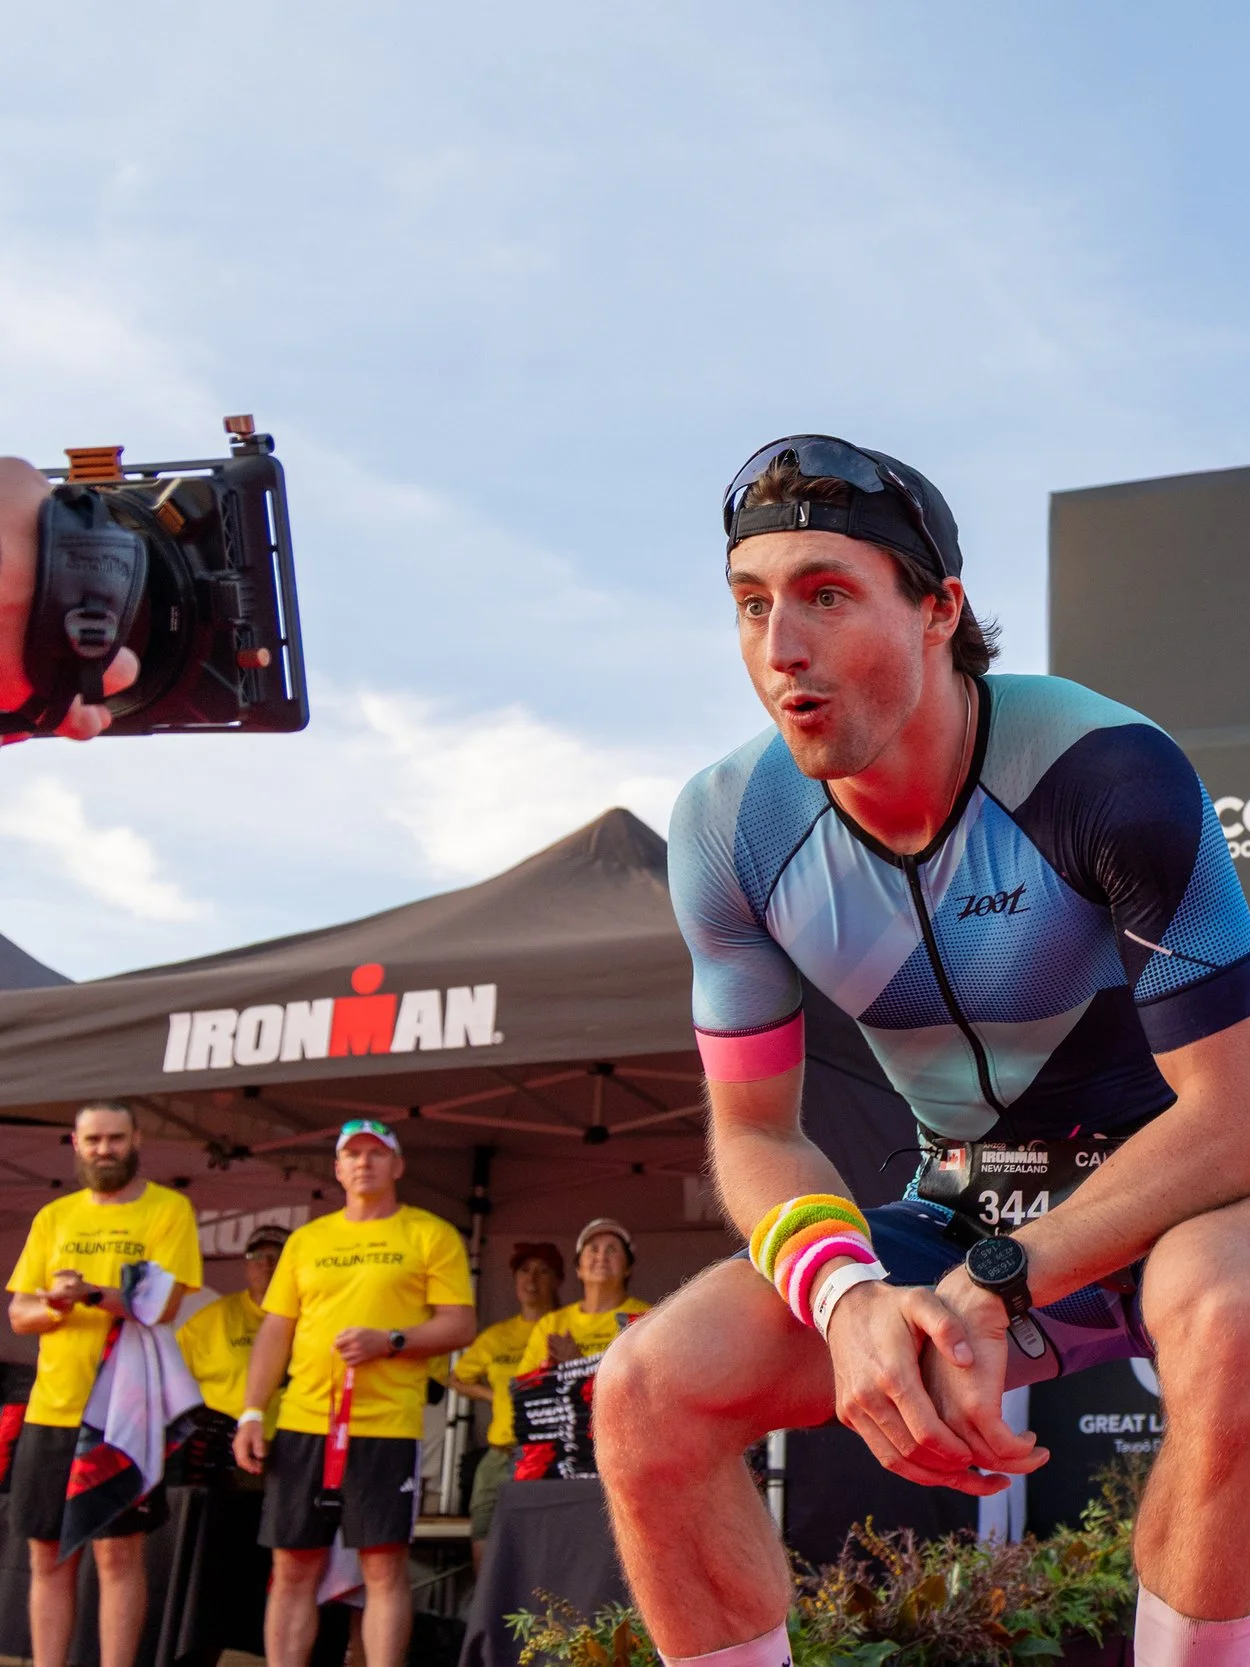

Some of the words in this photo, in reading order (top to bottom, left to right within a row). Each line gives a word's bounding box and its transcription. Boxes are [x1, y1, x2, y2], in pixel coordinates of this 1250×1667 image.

[162, 962, 498, 1073] IRONMAN
[981, 1144, 1049, 1165] IRONMAN
[981, 1164, 1003, 1174] NEW
[1004, 1165, 1048, 1175] ZEALAND
[978, 1189, 1050, 1226] 344
[59, 1240, 146, 1257] VOLUNTEER
[314, 1251, 404, 1269] VOLUNTEER
[1079, 1414, 1146, 1434] GREAT
